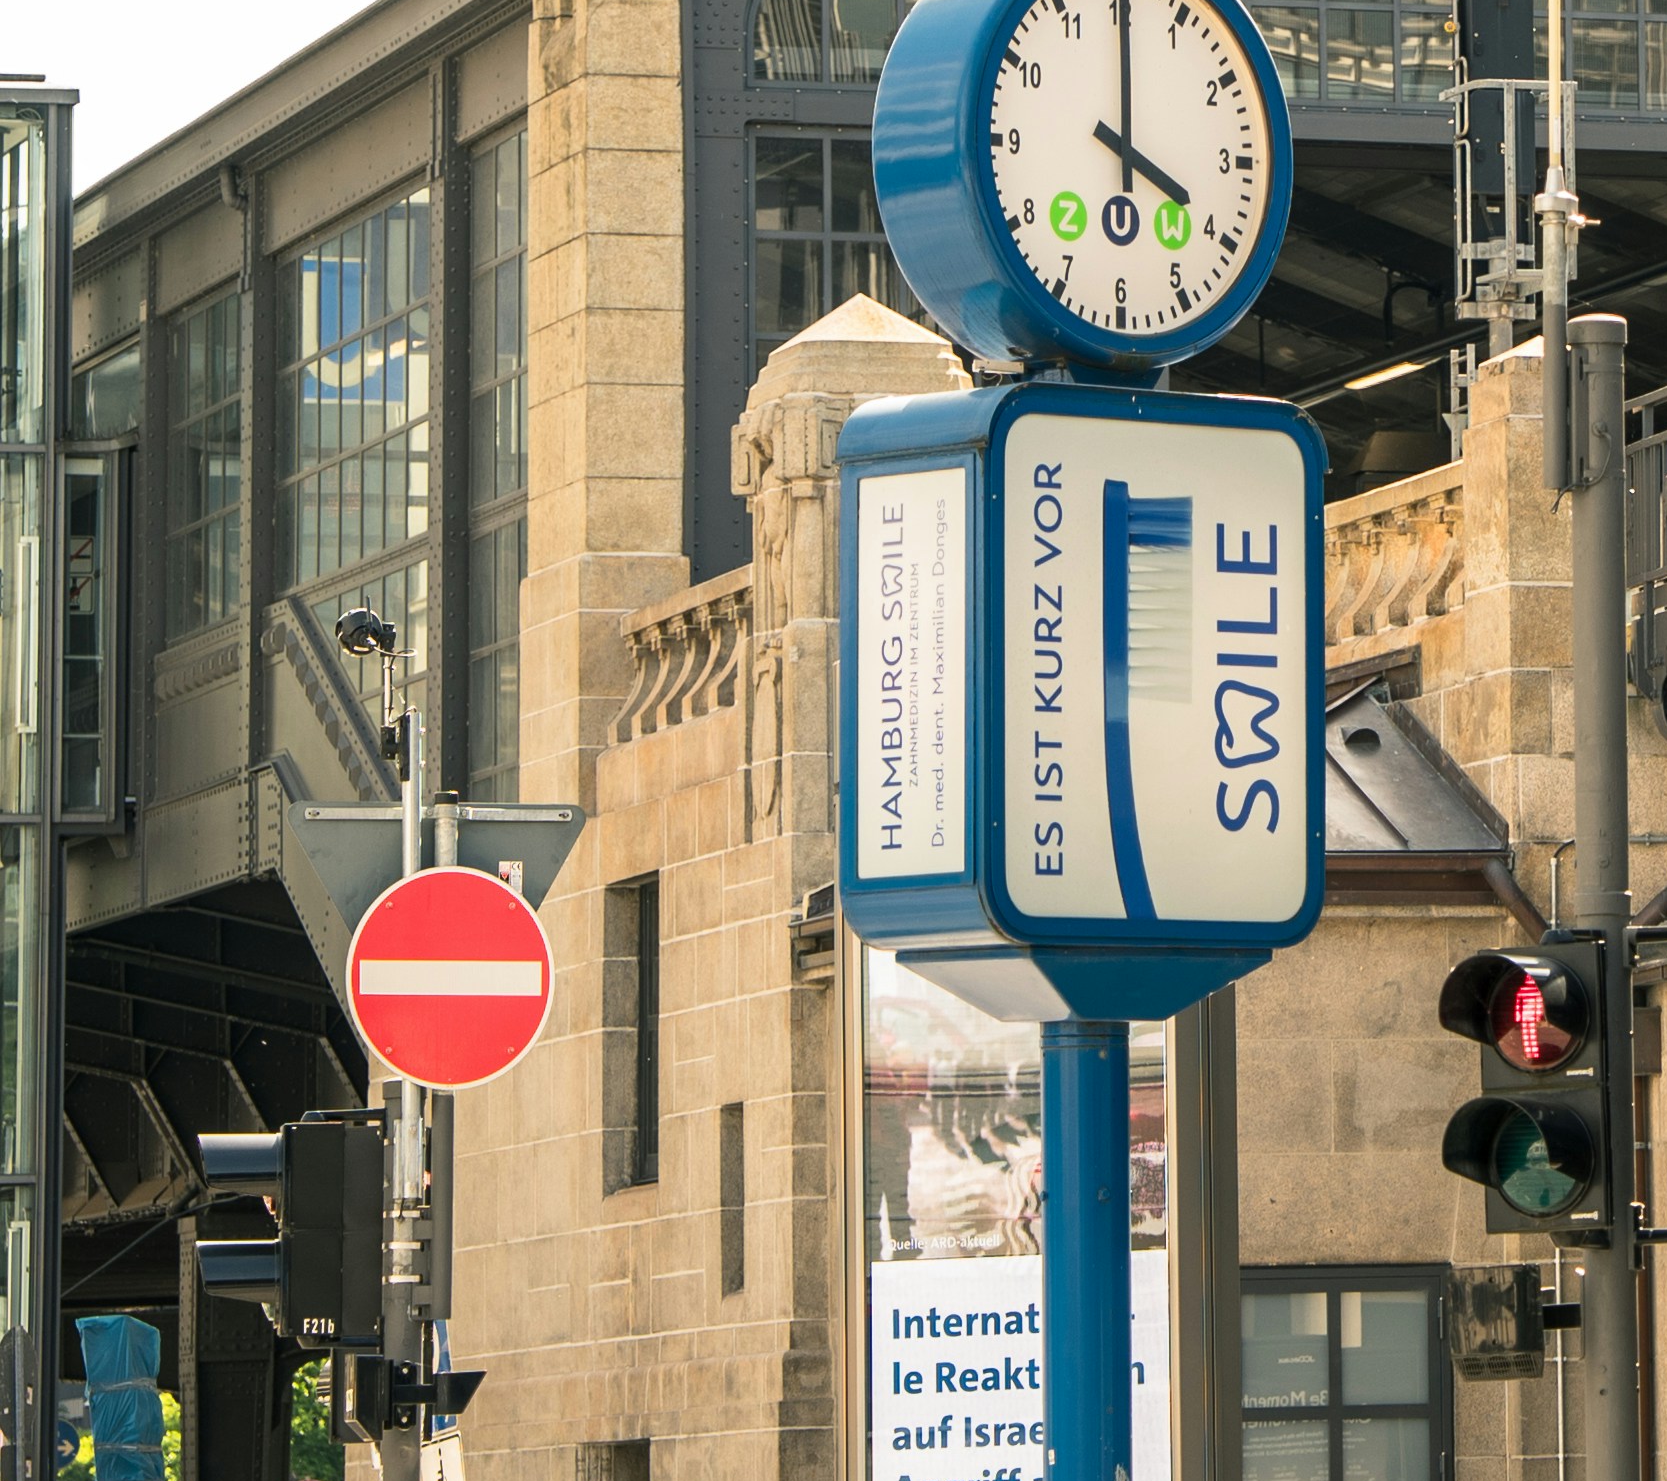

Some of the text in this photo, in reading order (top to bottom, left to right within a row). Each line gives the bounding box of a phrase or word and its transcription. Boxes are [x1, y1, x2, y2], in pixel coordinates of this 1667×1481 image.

[1061, 13, 1083, 40] 11
[1168, 23, 1177, 49] 1
[1019, 62, 1042, 90] 10
[1206, 80, 1218, 107] 2
[1008, 129, 1021, 156] 9
[1218, 148, 1231, 174] 3
[1023, 199, 1035, 225] 8
[1058, 200, 1185, 241] Z U W
[1204, 214, 1217, 241] 4
[1061, 255, 1074, 281] 7
[1169, 262, 1182, 289] 5
[1114, 278, 1127, 305] 6
[909, 563, 919, 788] ZAHNMEDIZIN IM ZENTRUM
[932, 499, 948, 847] Dr. med. dent. Maximilian Donges
[1034, 462, 1063, 876] ES IST KURZ VOR
[881, 635, 903, 851] HAMBURG
[931, 1234, 1000, 1249] ARD-aktuell
[303, 1318, 335, 1335] F21b
[893, 1303, 1040, 1339] Internat
[893, 1361, 923, 1394] le
[893, 1415, 1044, 1450] auf Israe
